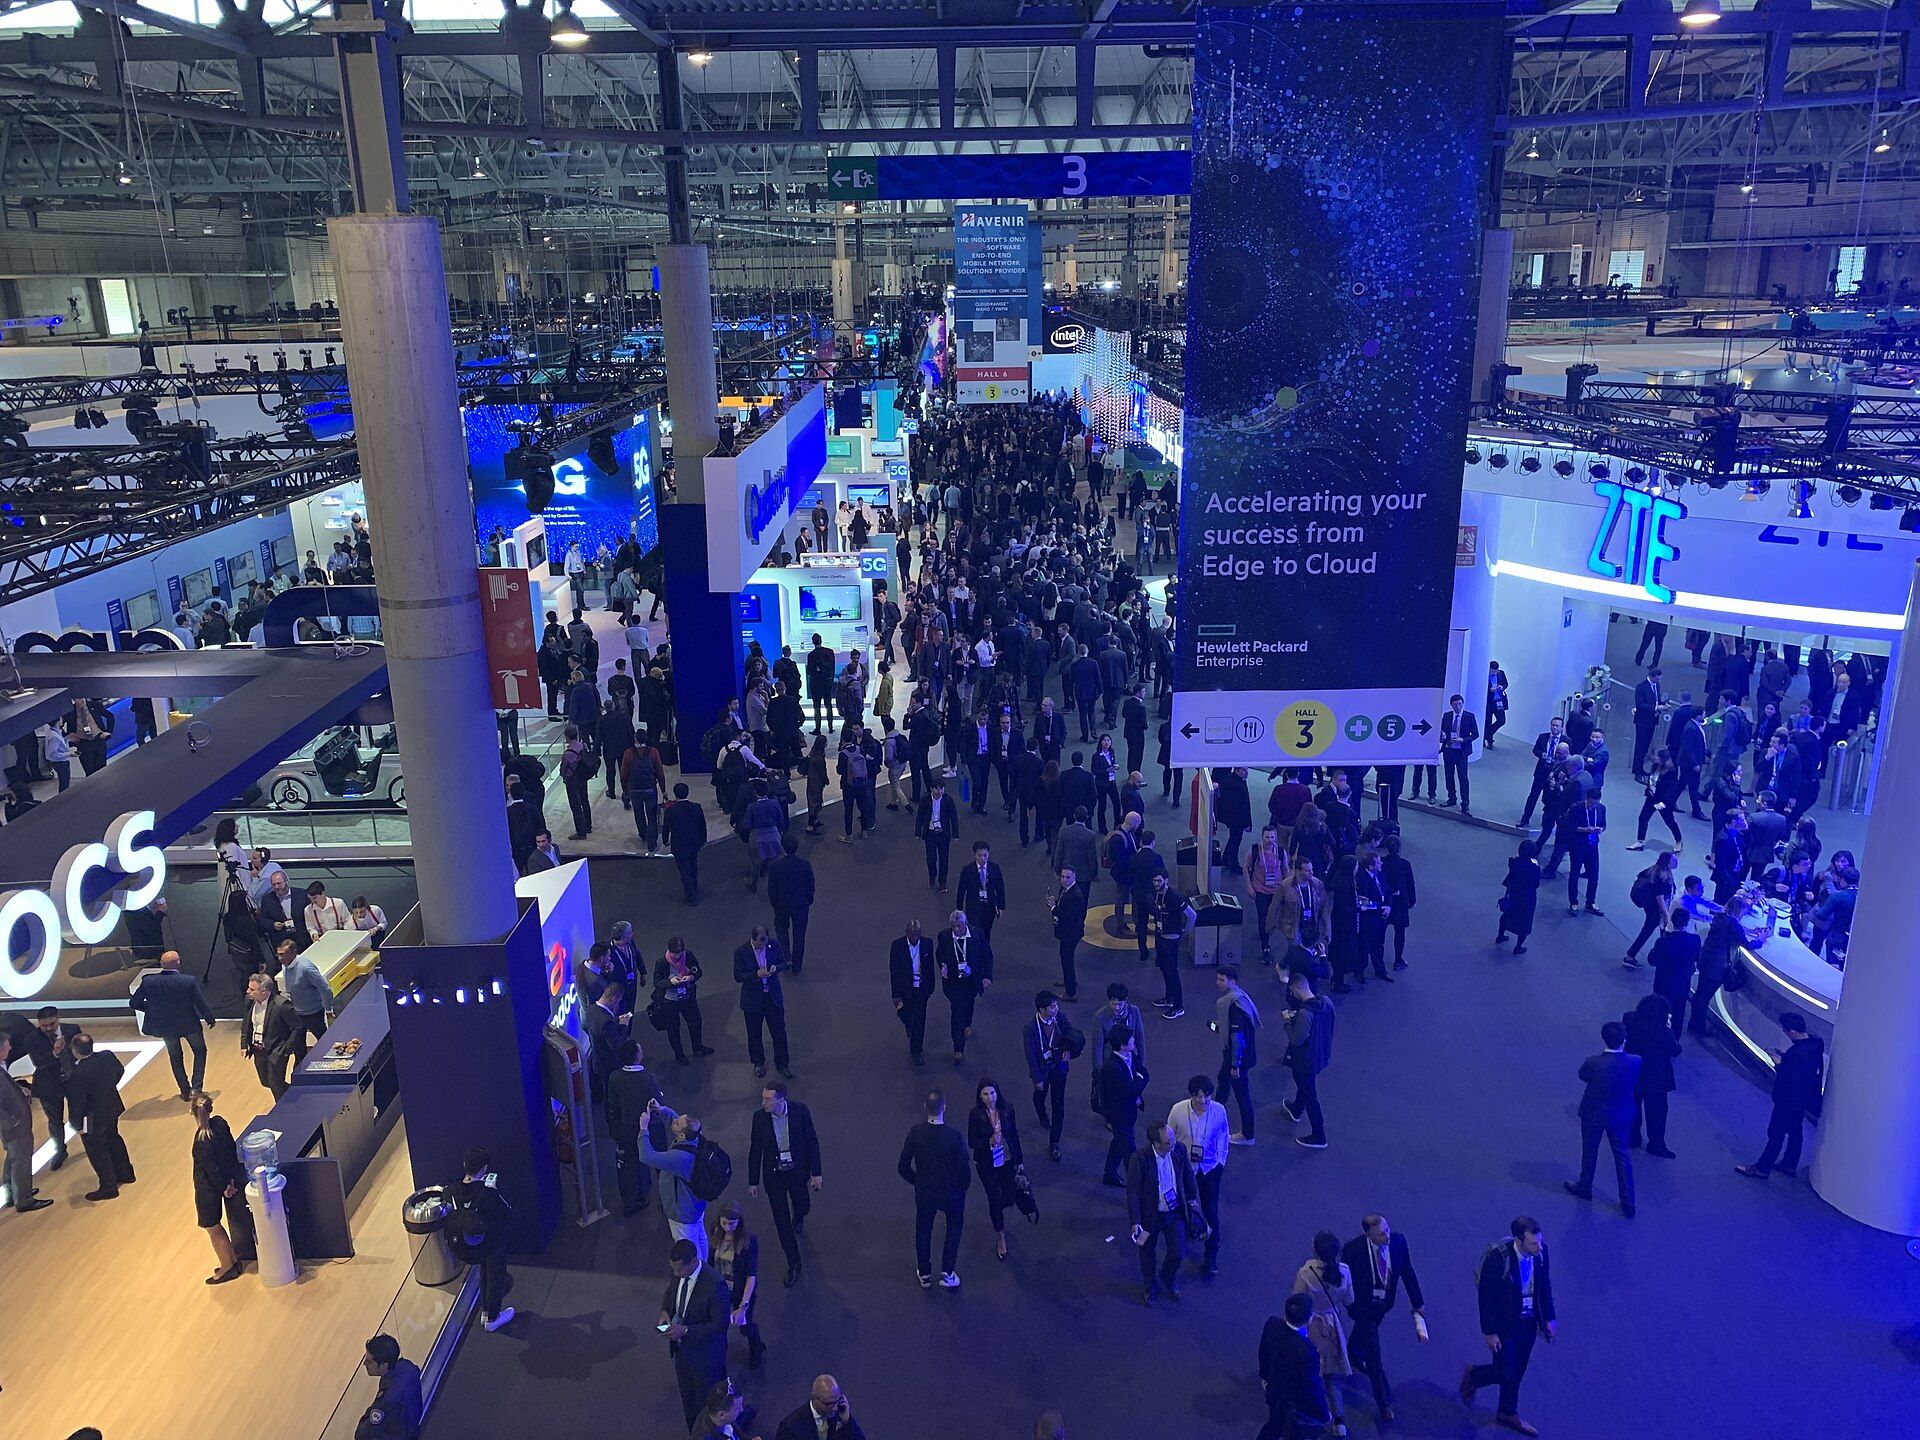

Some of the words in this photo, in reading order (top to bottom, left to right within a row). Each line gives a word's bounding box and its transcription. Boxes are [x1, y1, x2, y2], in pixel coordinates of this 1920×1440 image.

[1062, 155, 1087, 195] 3
[961, 213, 1024, 227] MAVENIR
[1055, 330, 1080, 342] intel
[990, 389, 996, 399] 3
[902, 421, 917, 431] 5G
[633, 447, 650, 490] 5G
[890, 465, 907, 477] 5G
[1204, 489, 1363, 517] Accelerating
[1370, 492, 1428, 516] your
[1203, 526, 1299, 546] success
[1306, 521, 1364, 543] from
[1588, 481, 1687, 605] ZTE
[863, 557, 887, 572] 5G
[1203, 554, 1265, 581] Edge
[1273, 555, 1298, 575] to
[1305, 552, 1378, 574] Cloud
[1196, 641, 1251, 653] Hewlett
[1252, 640, 1308, 653] Packard
[1196, 654, 1264, 669] Enterprise
[1295, 709, 1318, 717] HALL
[1295, 719, 1315, 749] 3
[1386, 723, 1396, 737] 5
